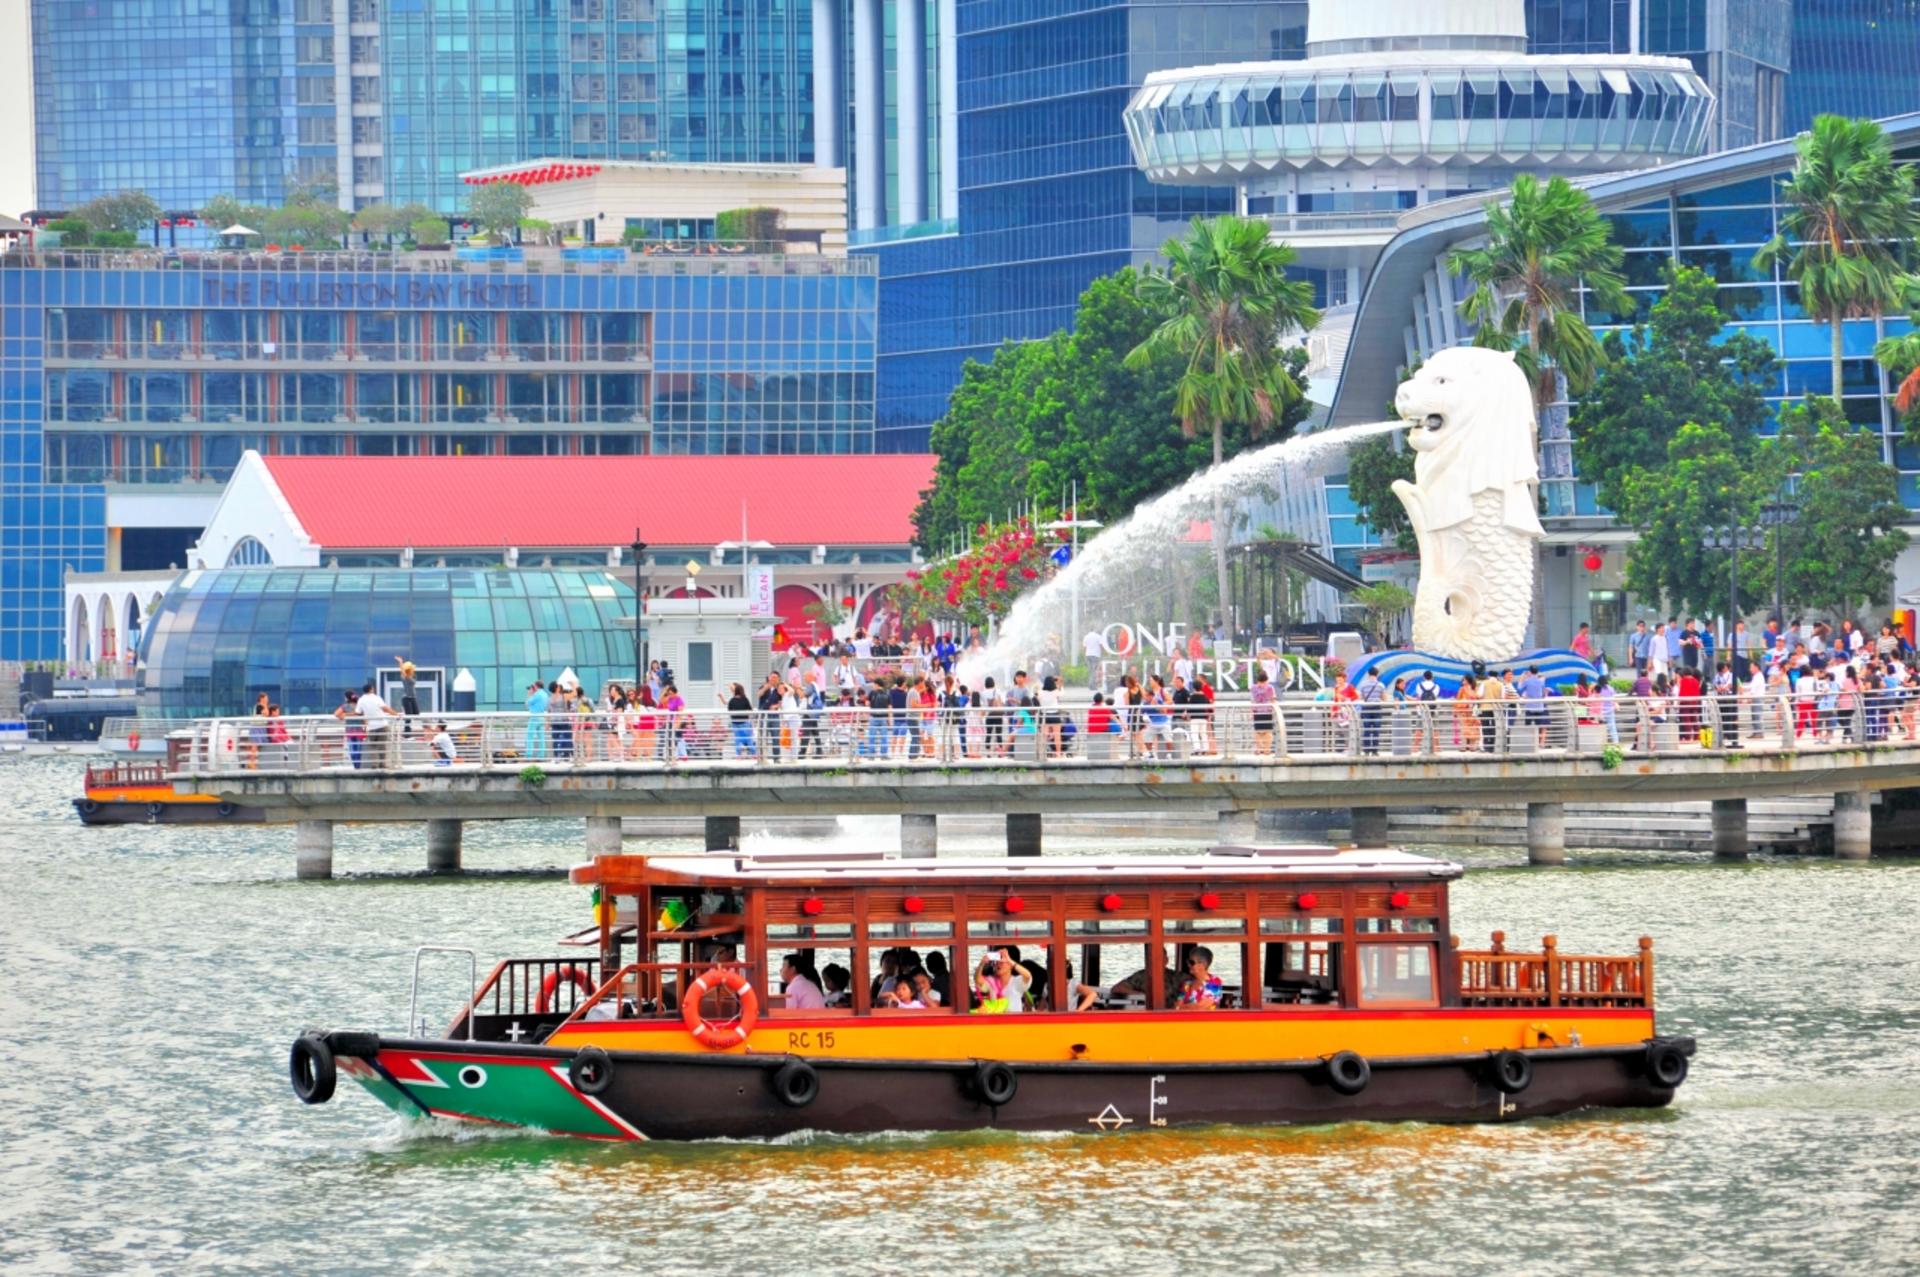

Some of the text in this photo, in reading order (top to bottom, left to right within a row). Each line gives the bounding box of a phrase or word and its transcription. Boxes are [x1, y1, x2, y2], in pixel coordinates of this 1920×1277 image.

[204, 279, 537, 306] THE FULLERTON BAY HOTEL
[759, 574, 769, 612] LICAN
[1101, 656, 1326, 692] FUERTON
[788, 1031, 835, 1048] RC 15
